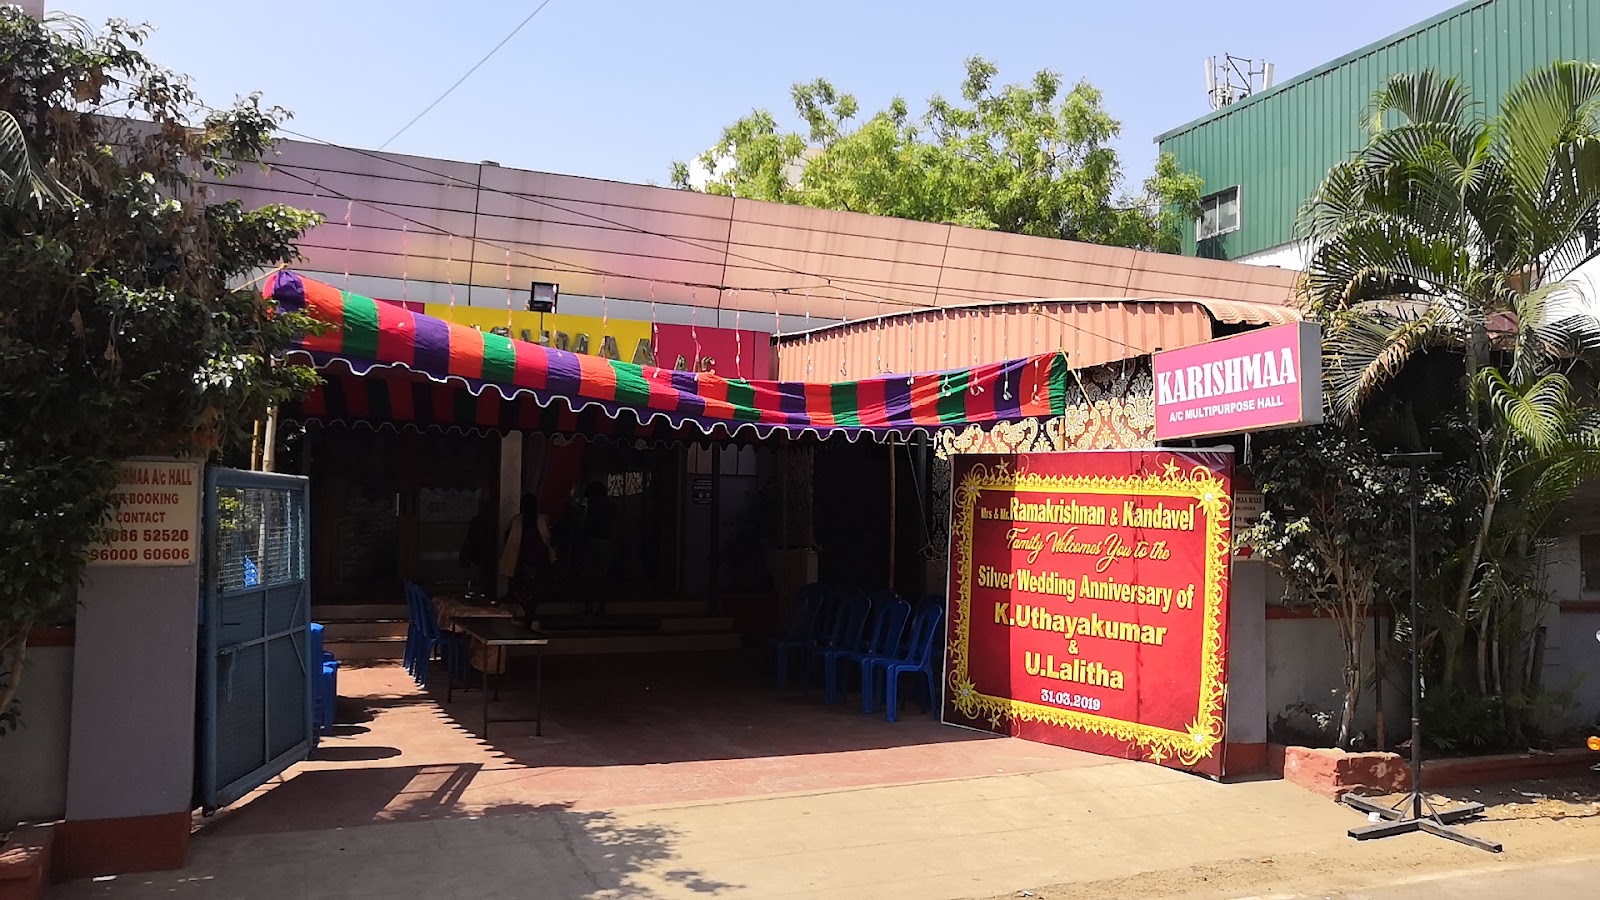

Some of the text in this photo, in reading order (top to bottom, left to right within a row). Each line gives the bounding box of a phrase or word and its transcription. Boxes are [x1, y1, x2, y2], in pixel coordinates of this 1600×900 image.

[1157, 347, 1297, 405] KARISHMAA
[1169, 394, 1284, 423] A/C MULTIPURPOSE HALL
[168, 469, 193, 486] HALL
[129, 493, 180, 505] BOOKING
[116, 512, 166, 524] CONTACT
[994, 507, 999, 520] &
[1109, 507, 1119, 526] &
[1122, 500, 1195, 531] Kandavel
[143, 529, 189, 542] 52520
[90, 548, 190, 561] 96000 60606
[1005, 526, 1171, 573] Family Welcomes You to the
[977, 565, 1195, 613] Silver Wedding Anniversary of
[993, 601, 1168, 646] K.Uthayakumar
[1067, 639, 1079, 655] &
[1024, 650, 1124, 690] U.Lalitha
[1040, 687, 1101, 711] 31.03.2019
